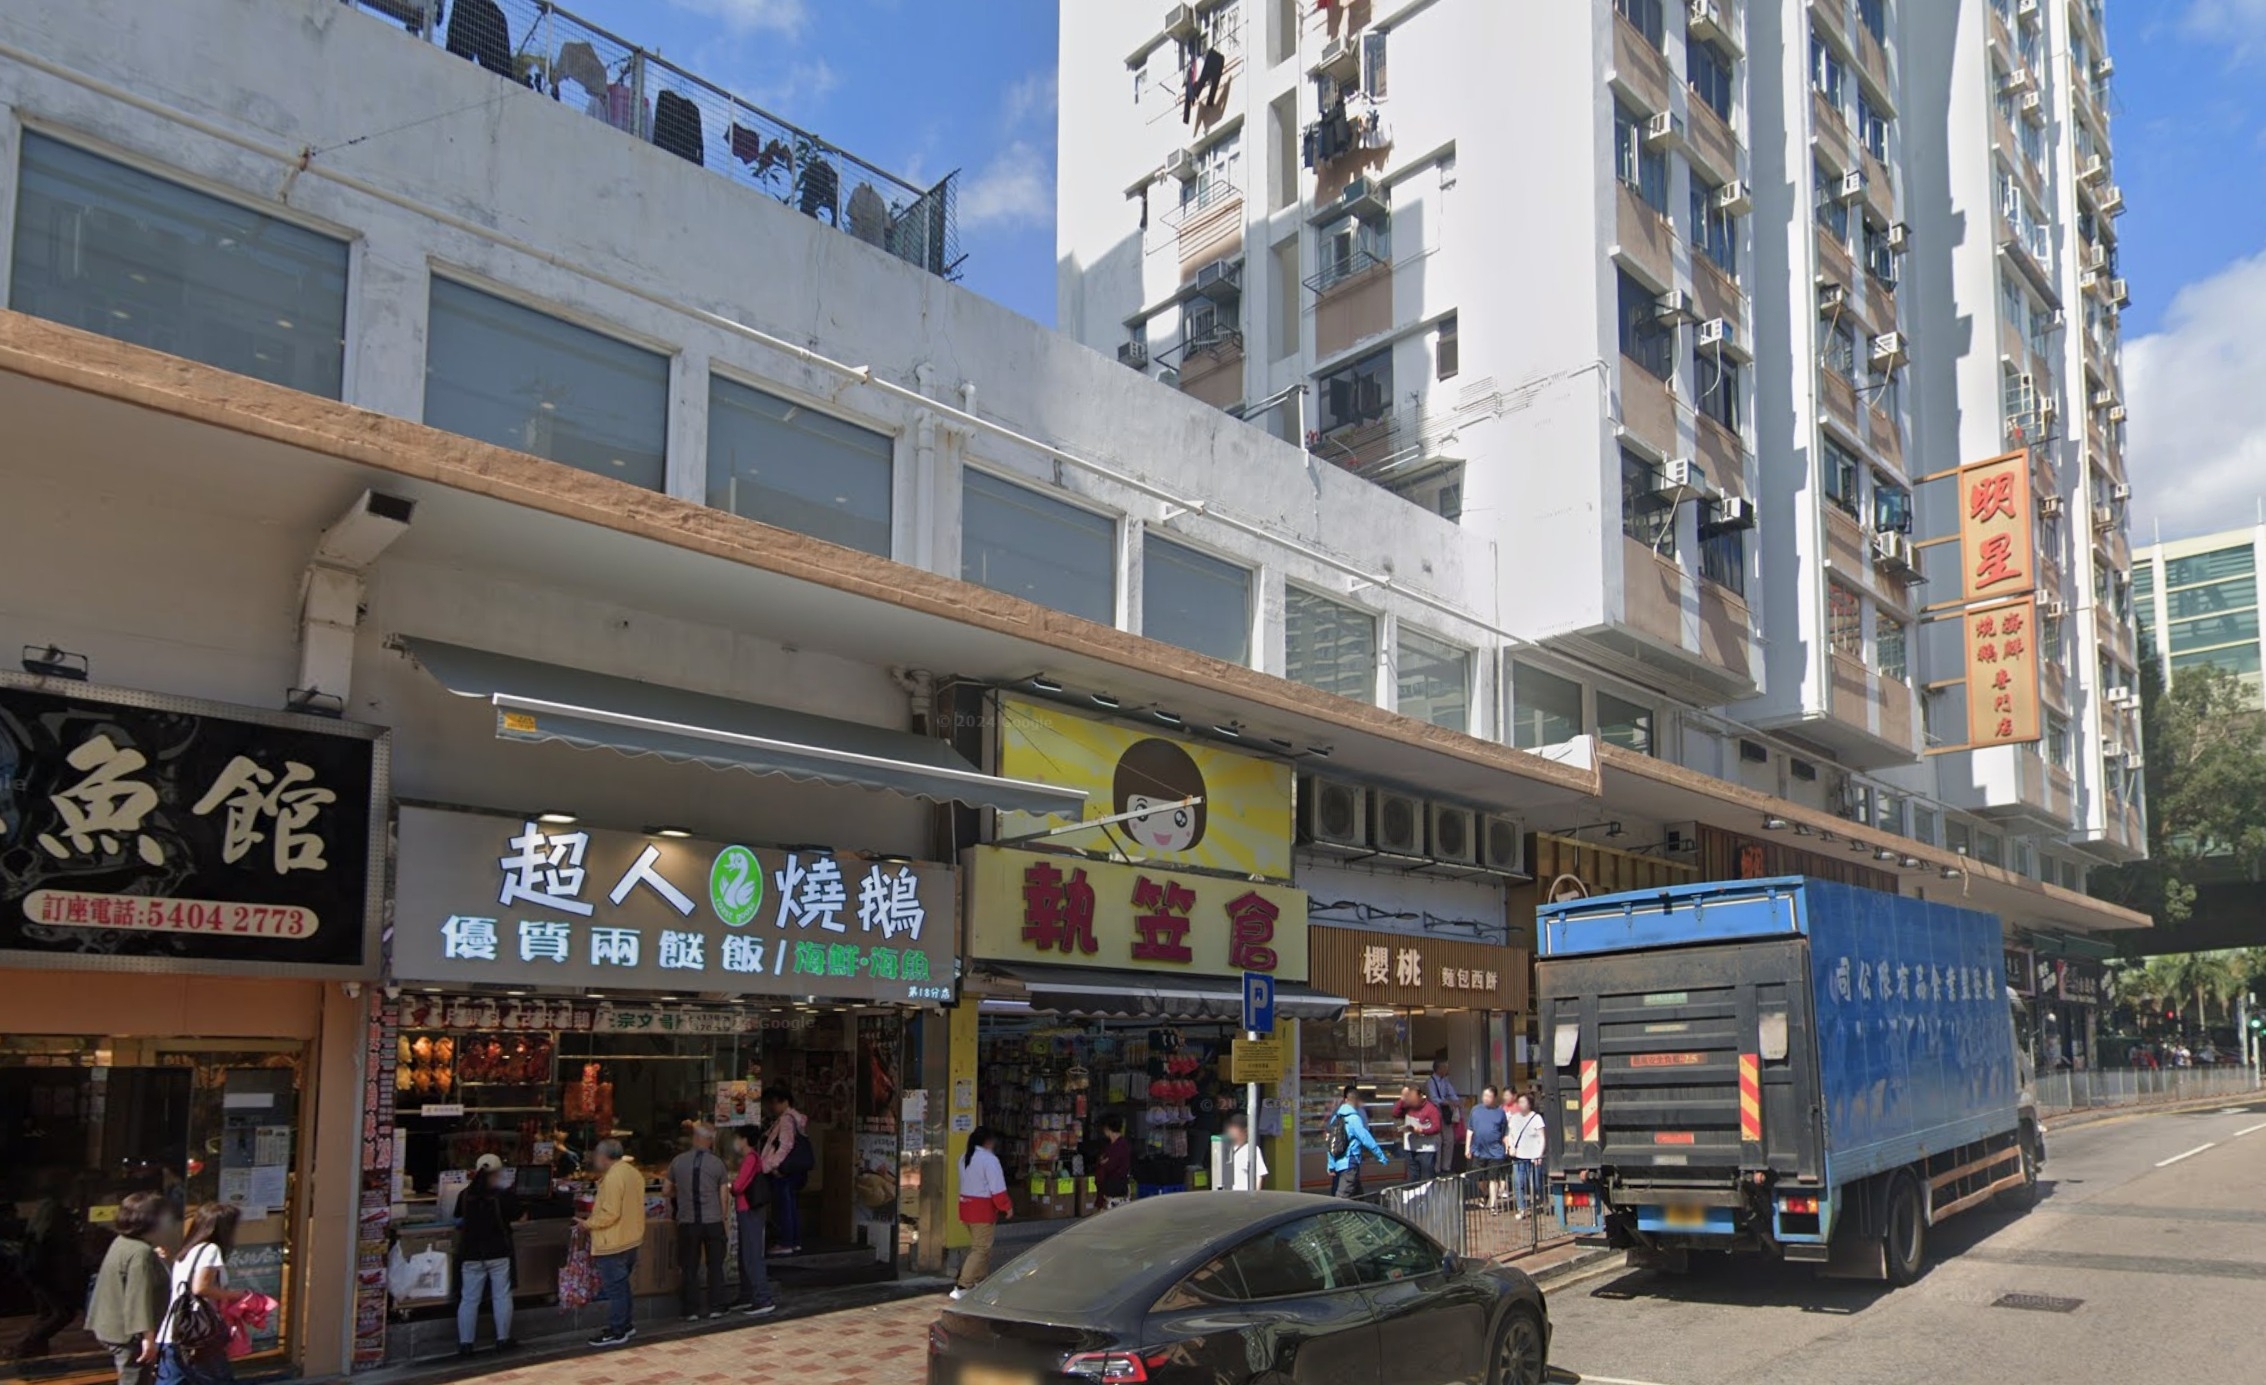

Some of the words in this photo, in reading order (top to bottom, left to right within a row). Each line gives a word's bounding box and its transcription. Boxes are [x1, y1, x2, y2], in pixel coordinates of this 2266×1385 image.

[1969, 470, 2022, 590] 明星
[2002, 612, 2025, 660] 海鮮
[1991, 669, 2013, 738] 專門店
[37, 734, 337, 875] 魚館
[499, 820, 697, 917] 超人
[774, 853, 927, 941] 燒鵝
[233, 905, 305, 935] 2773
[1022, 860, 1280, 972] 執笠倉
[908, 986, 950, 999] 第18分店
[1362, 945, 1421, 986] 櫻桃
[1441, 966, 1498, 991] 麵包西餅
[1249, 978, 1268, 1026] P
